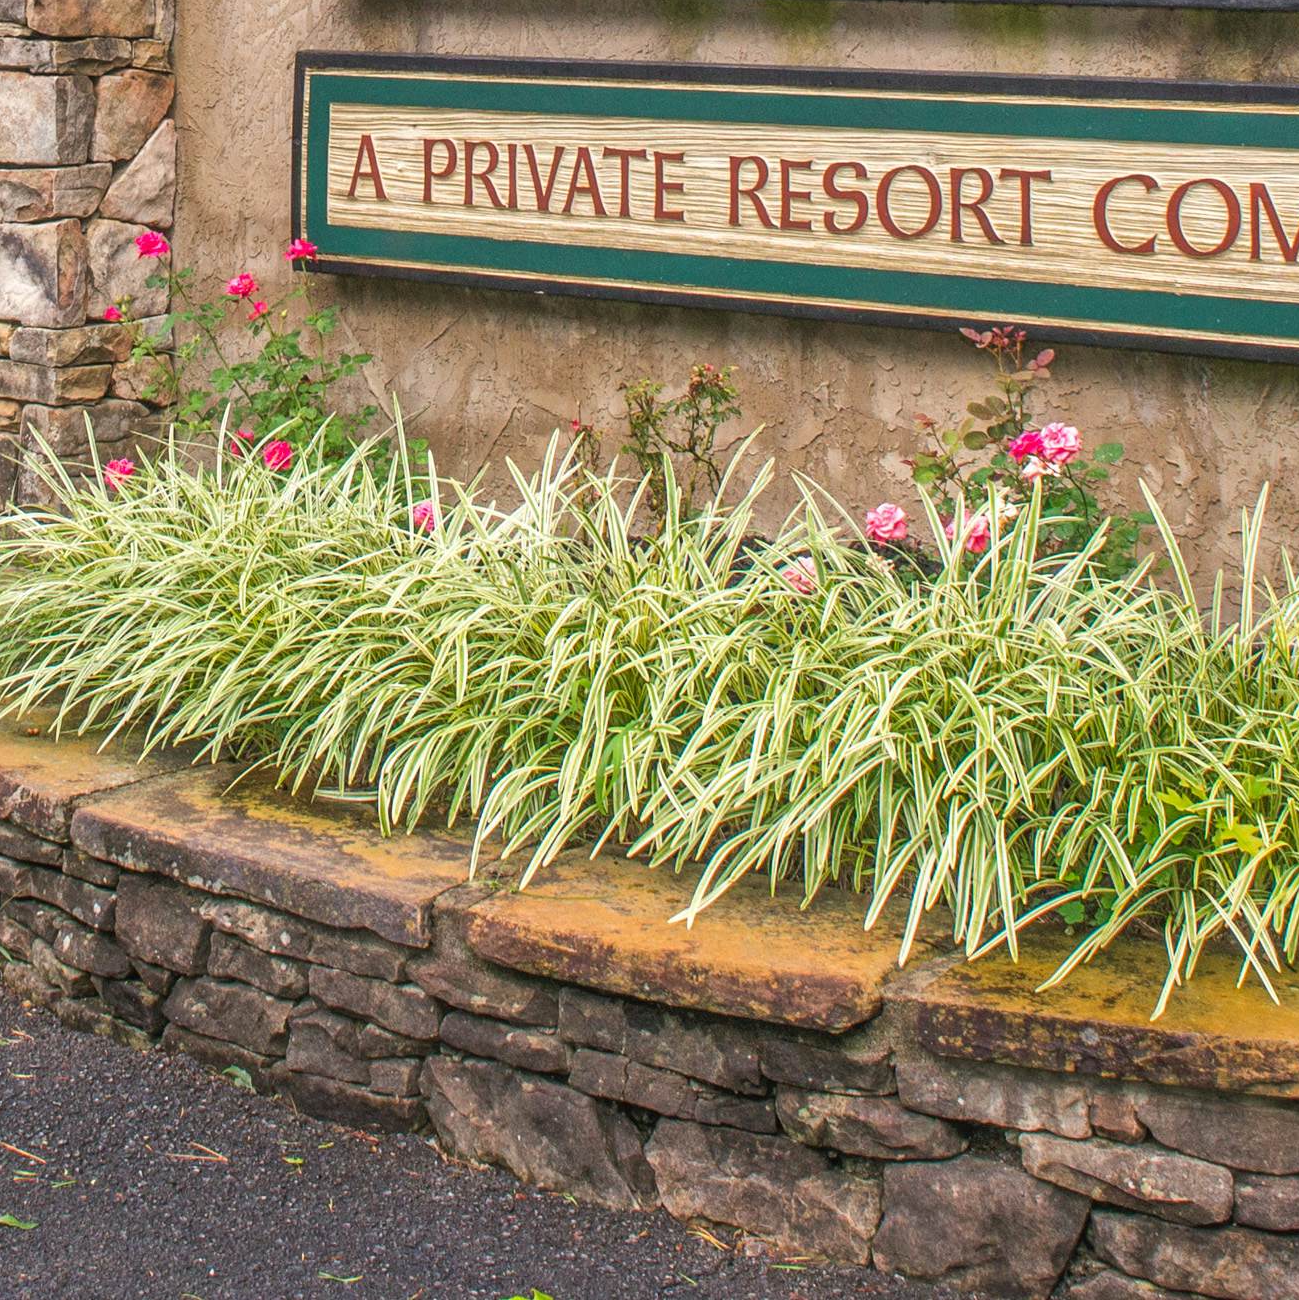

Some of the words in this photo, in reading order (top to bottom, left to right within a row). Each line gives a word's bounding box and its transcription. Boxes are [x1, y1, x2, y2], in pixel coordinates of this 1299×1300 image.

[348, 134, 386, 199] A
[422, 137, 685, 222] PRIVATE
[728, 155, 1052, 247] RESORT
